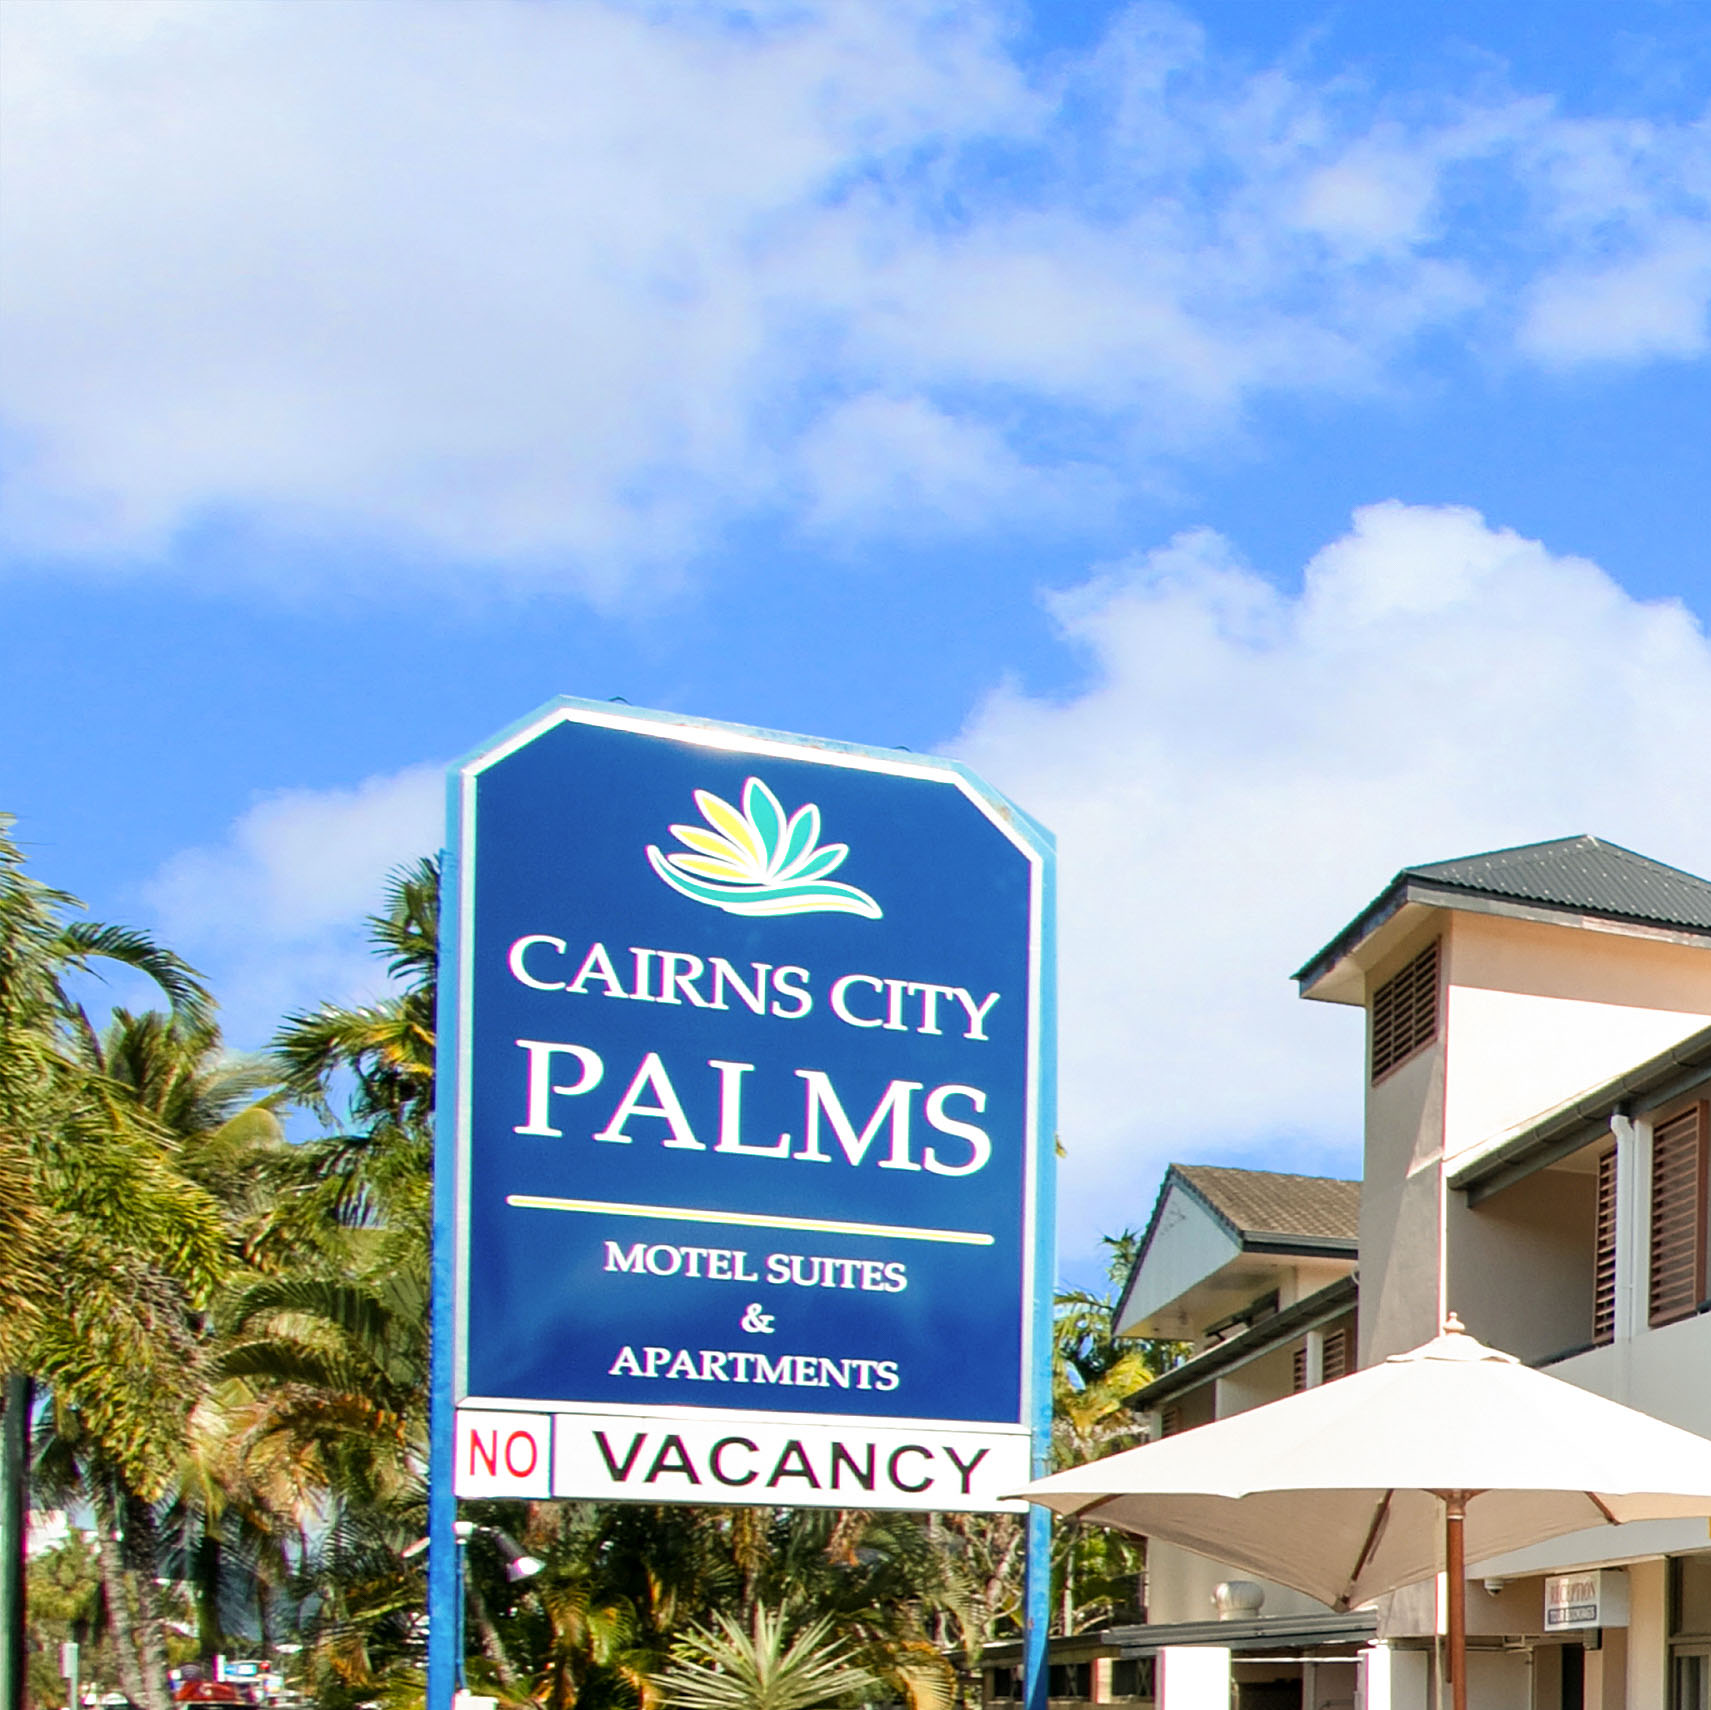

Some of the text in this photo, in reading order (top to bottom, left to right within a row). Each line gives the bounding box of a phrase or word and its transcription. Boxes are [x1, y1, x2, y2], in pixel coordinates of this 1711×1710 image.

[507, 935, 1000, 1040] CAIRNS CITY
[513, 1039, 992, 1176] PALMS
[603, 1241, 908, 1292] MOTEL SUITES
[741, 1303, 774, 1334] &
[608, 1347, 899, 1391] APARTMENTS
[470, 1430, 538, 1478] NO
[594, 1431, 990, 1495] VACANCY
